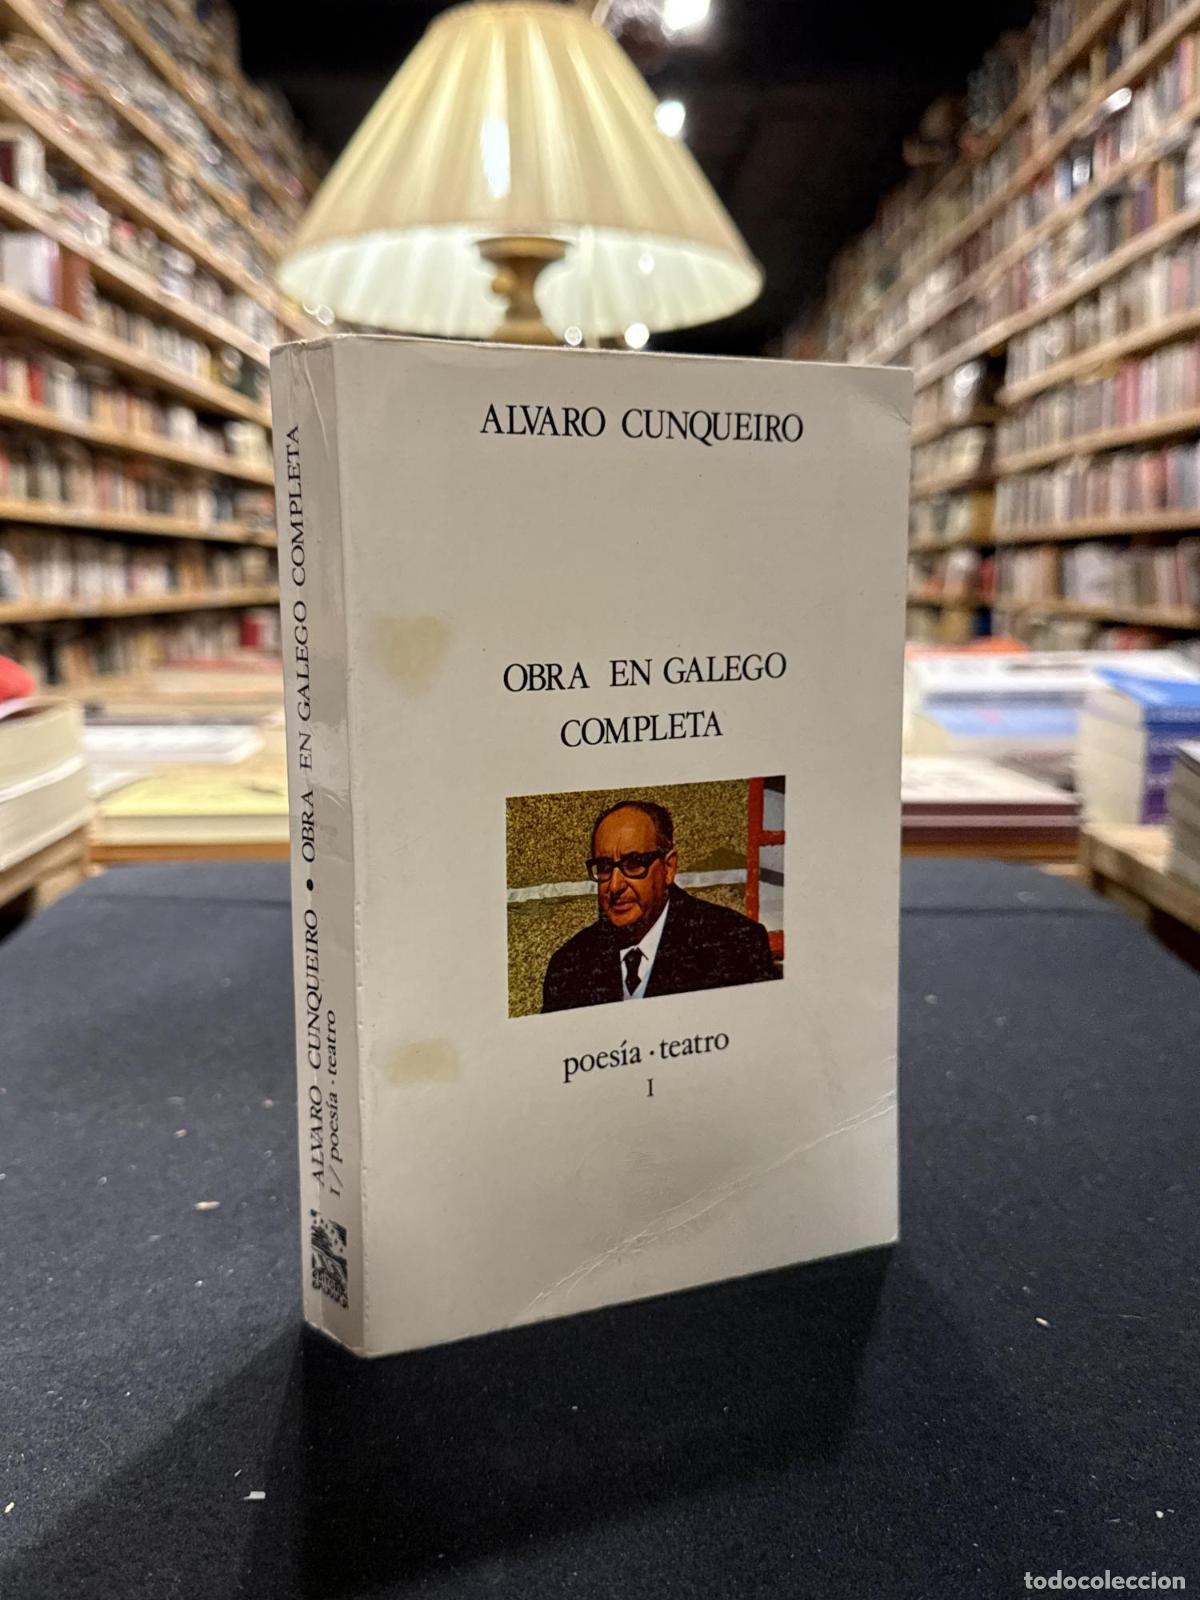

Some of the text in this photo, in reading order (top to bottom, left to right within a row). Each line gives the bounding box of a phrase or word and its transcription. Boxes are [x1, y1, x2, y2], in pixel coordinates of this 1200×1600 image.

[480, 403, 804, 446] ALVARO CUNQUEIRO
[503, 651, 787, 692] OBRA EN GALEGO
[560, 710, 724, 747] COMPLETA
[286, 424, 325, 1187] ALVARO CUNQUEIRO OBRA EN GALEGO COMPLETA
[563, 1032, 730, 1083] poesía teatro
